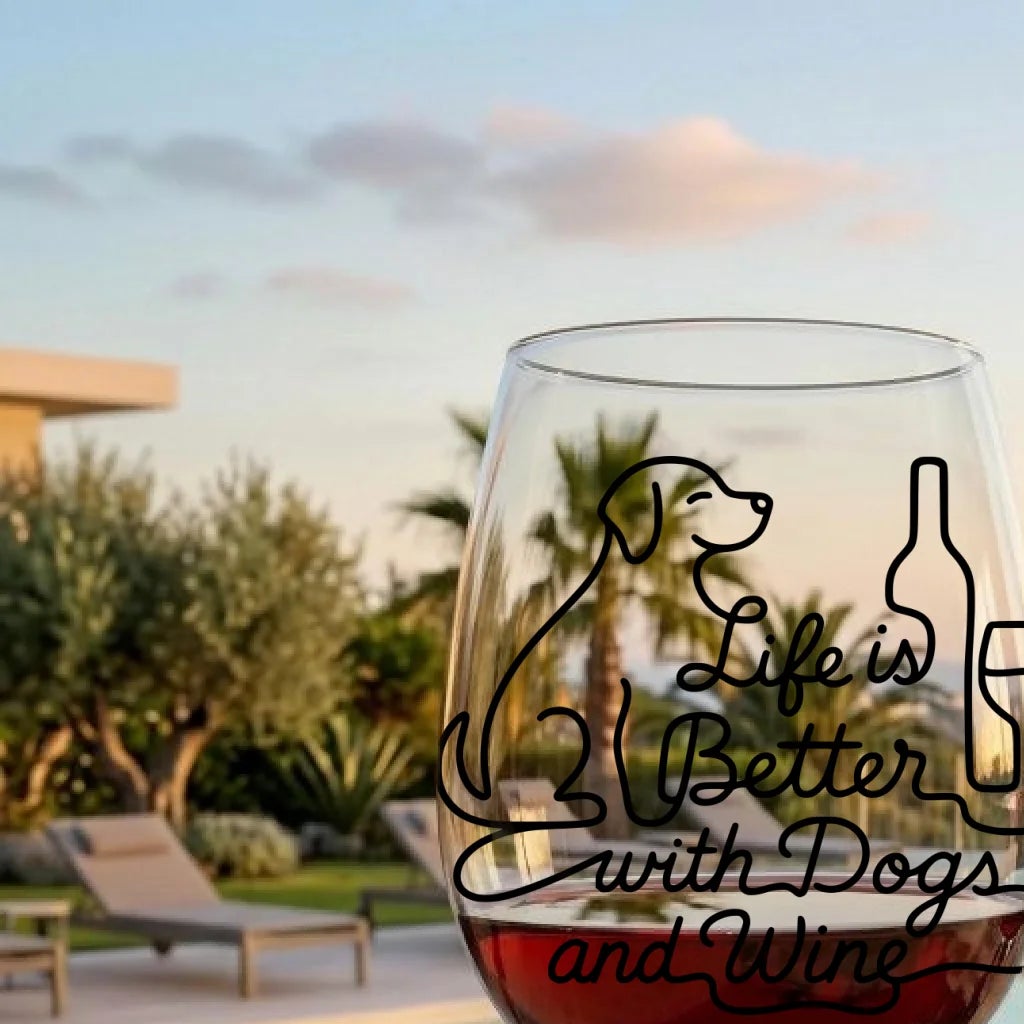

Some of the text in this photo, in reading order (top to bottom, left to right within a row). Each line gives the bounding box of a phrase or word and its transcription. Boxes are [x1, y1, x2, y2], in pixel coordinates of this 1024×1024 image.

[677, 596, 926, 717] Life is
[688, 712, 928, 806] Better
[595, 816, 1000, 937] with Dogs
[548, 908, 911, 986] and Wine
